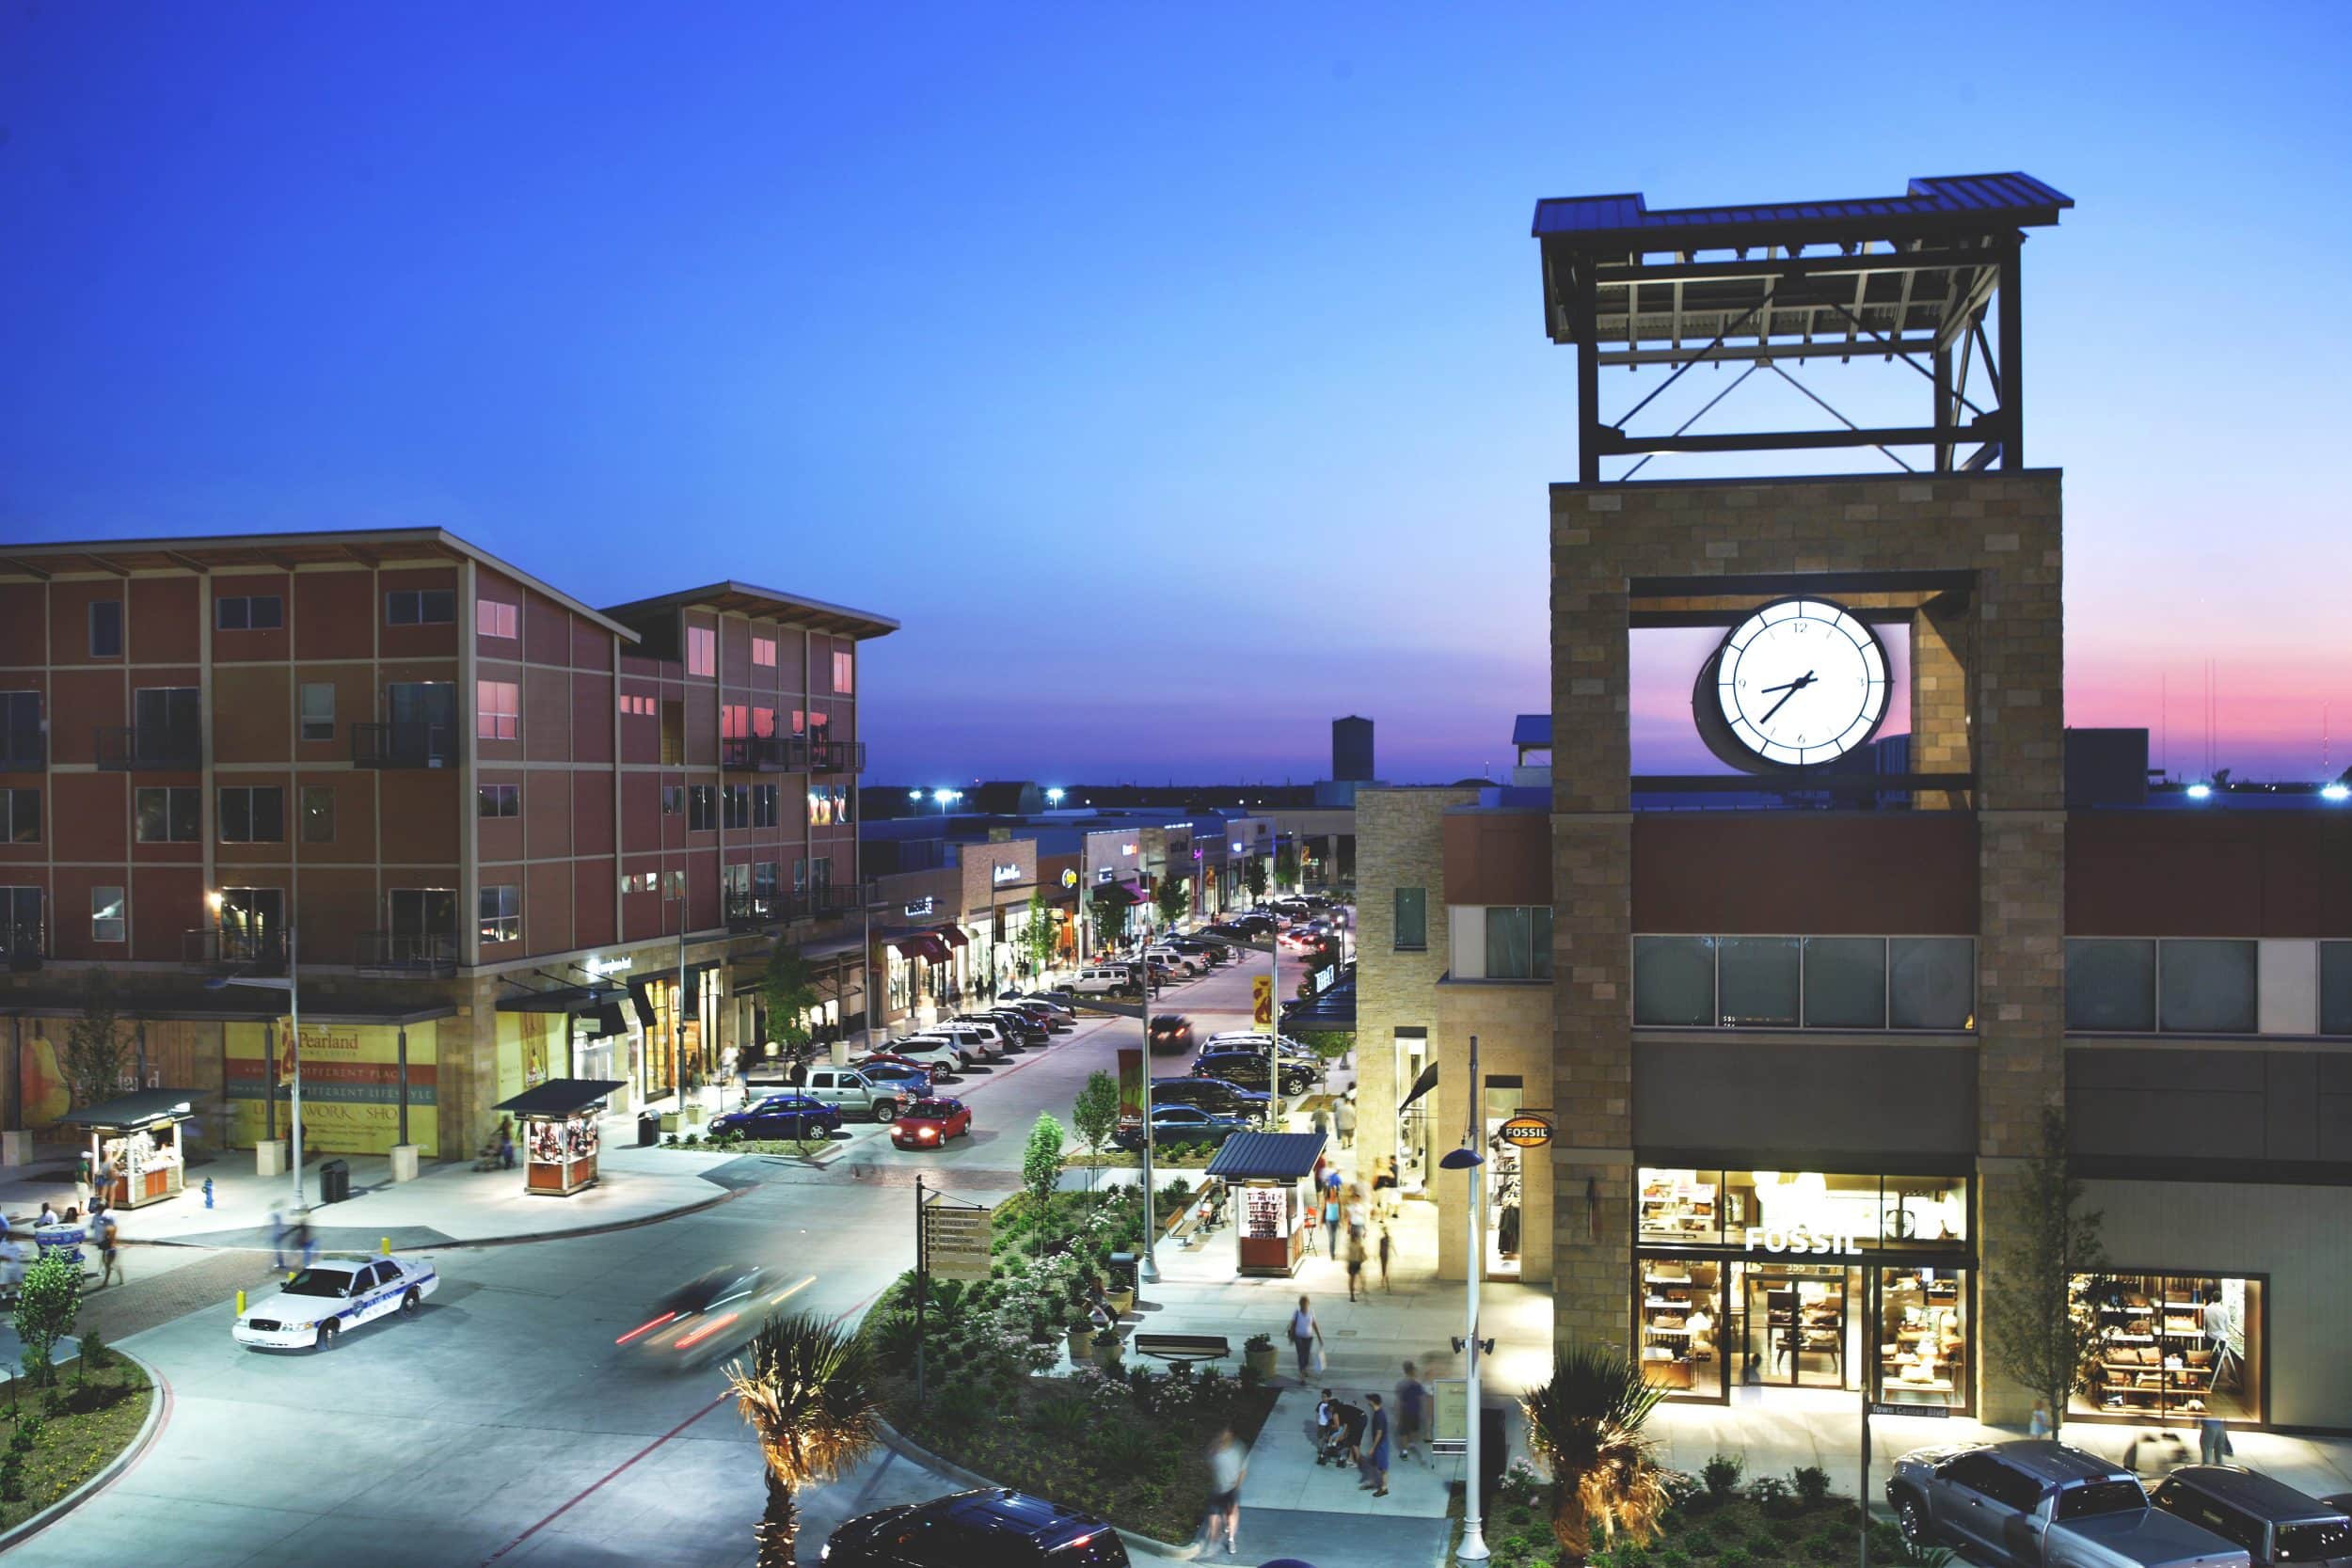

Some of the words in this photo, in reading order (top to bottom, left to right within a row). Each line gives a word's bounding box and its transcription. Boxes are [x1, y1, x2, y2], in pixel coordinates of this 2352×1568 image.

[1793, 623, 1807, 634] 12
[1739, 677, 1747, 689] 9
[1858, 676, 1865, 688] 3
[1797, 734, 1806, 744] 6
[298, 1032, 358, 1050] Pearland
[370, 1069, 399, 1079] PLAC
[369, 1088, 433, 1100] LIFESYLE
[253, 1102, 287, 1116] LIE
[303, 1104, 354, 1119] WORK
[367, 1108, 398, 1119] SHO
[1505, 1128, 1548, 1137] FOSSIL
[1745, 1227, 1863, 1256] FOSSIL
[1872, 1404, 1895, 1415] Town
[1896, 1405, 1925, 1416] Center
